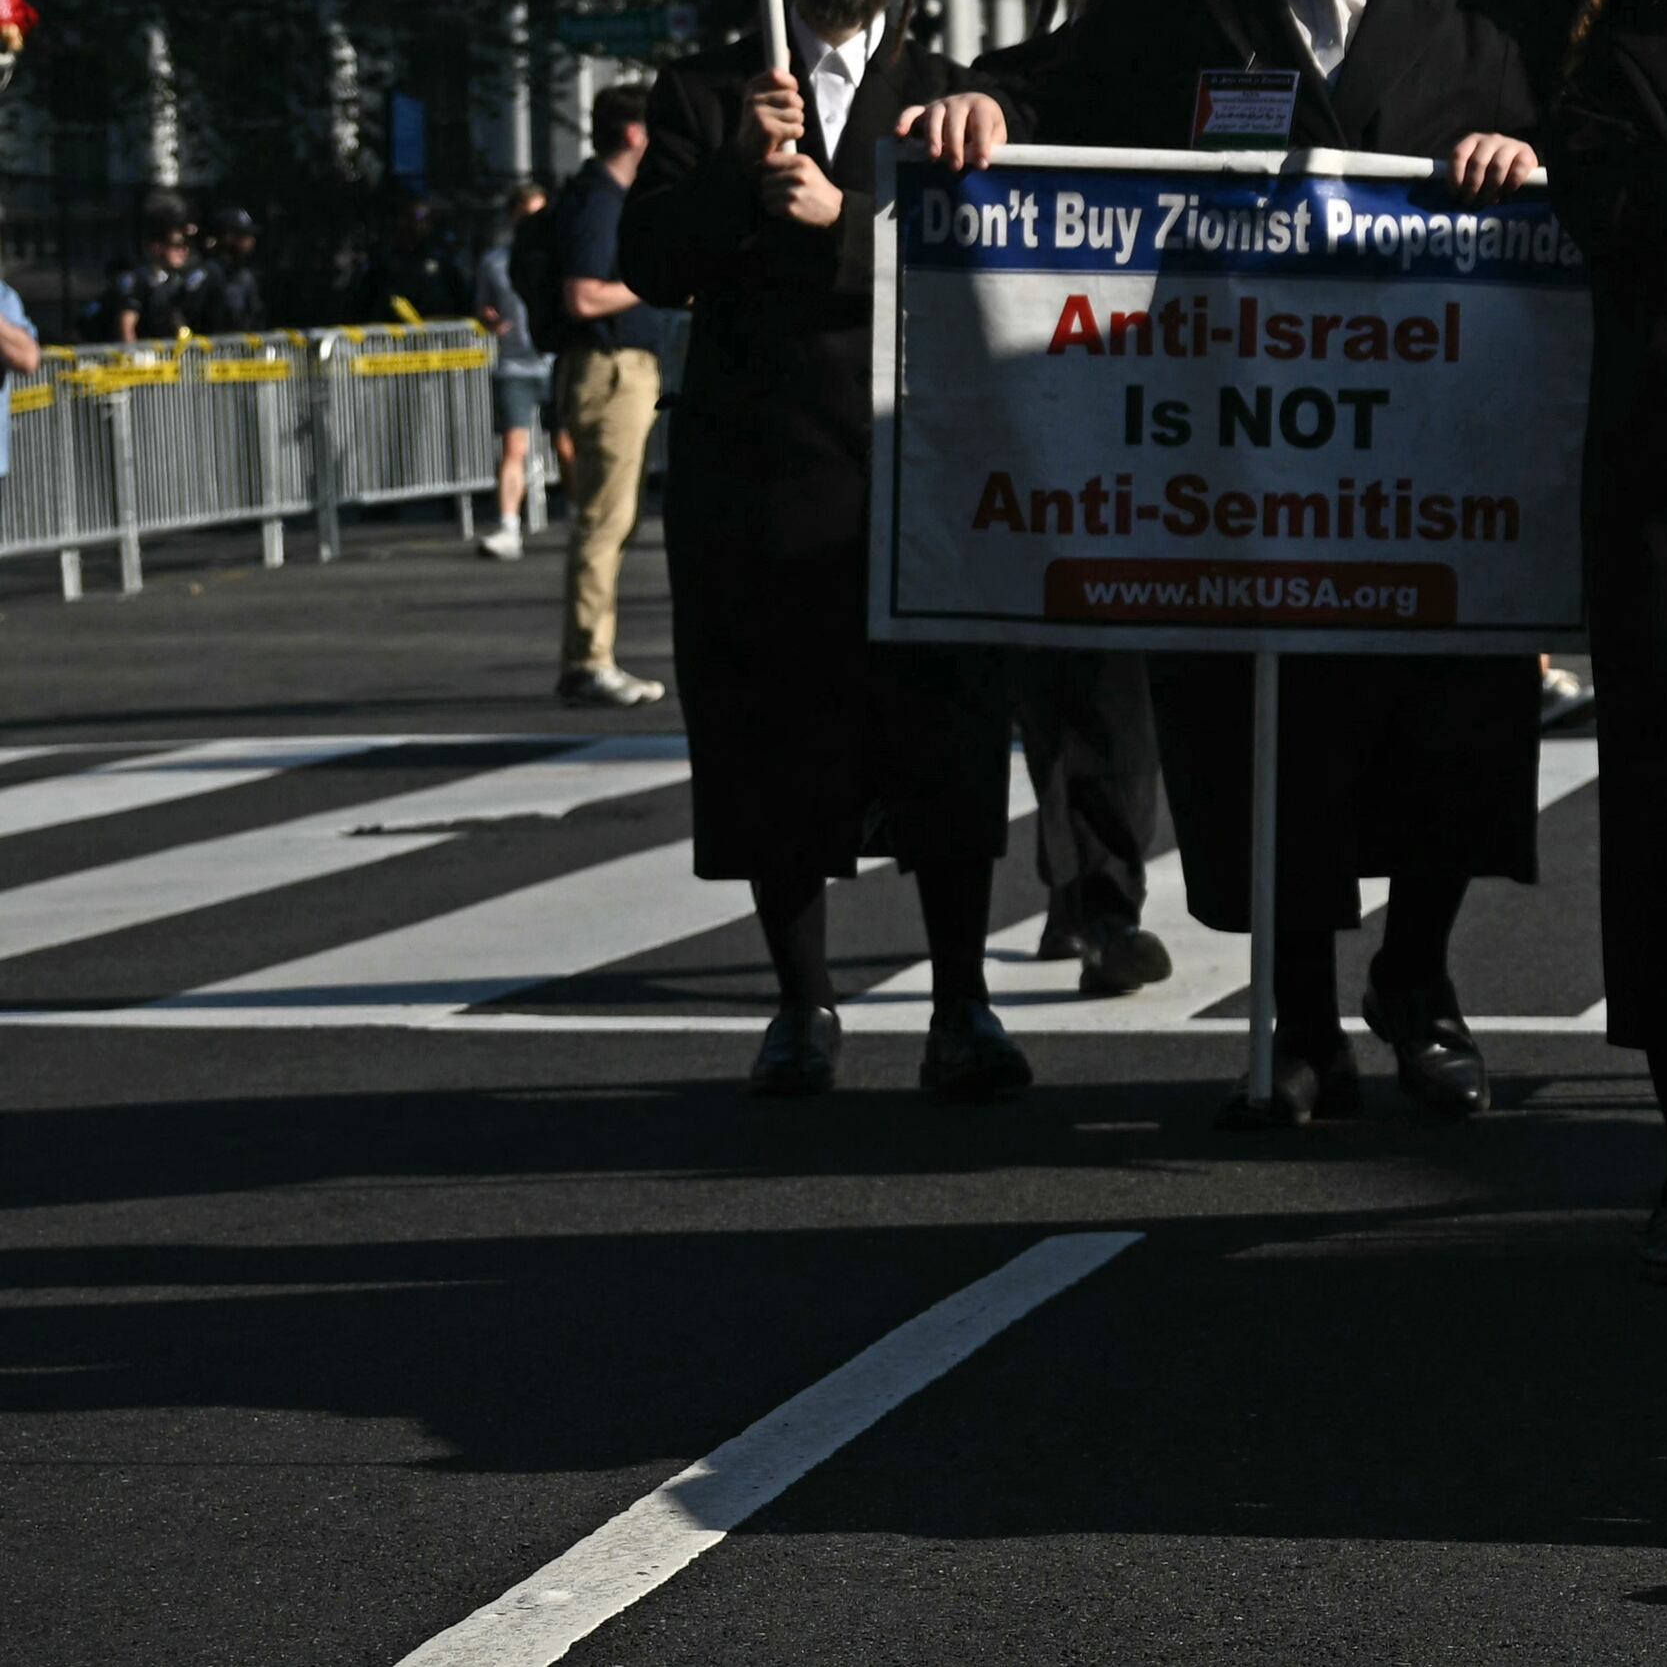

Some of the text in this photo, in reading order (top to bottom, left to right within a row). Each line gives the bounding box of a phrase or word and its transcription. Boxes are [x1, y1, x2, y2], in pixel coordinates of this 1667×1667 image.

[922, 189, 1582, 274] Don't Buy Zionist Propaganda
[1047, 294, 1459, 363] Anti-Israel
[1124, 386, 1390, 449] Is NOT
[972, 471, 1520, 542] Anti-Semitism
[1083, 575, 1419, 615] www.NKUSA.org
